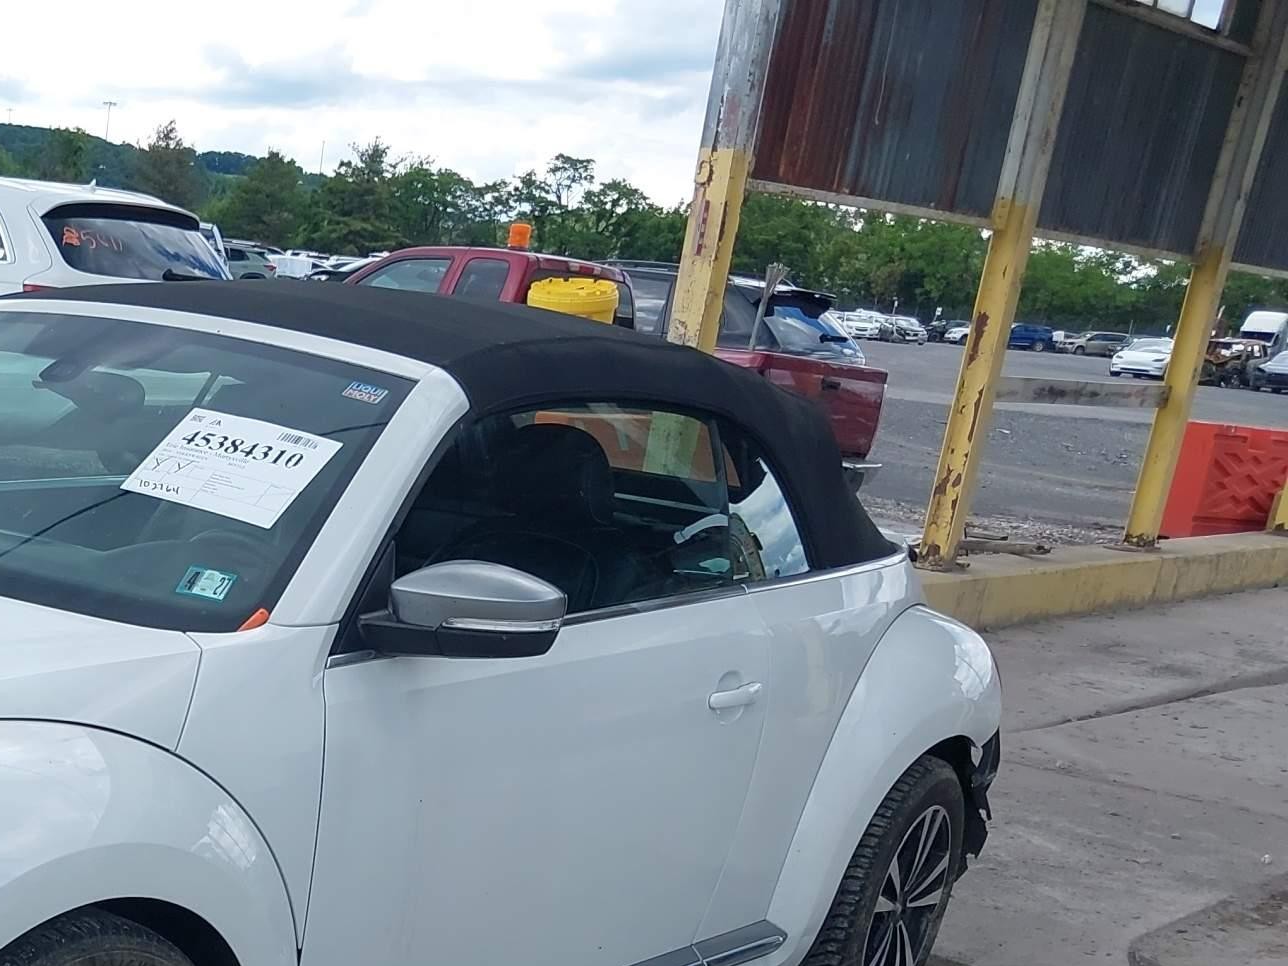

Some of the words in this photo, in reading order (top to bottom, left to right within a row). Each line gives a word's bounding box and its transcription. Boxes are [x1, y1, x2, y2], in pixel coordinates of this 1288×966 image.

[345, 389, 378, 402] MOLY
[351, 383, 383, 396] LIQUI
[181, 430, 304, 469] 45384310
[184, 571, 200, 591] 4
[213, 576, 232, 597] 27
